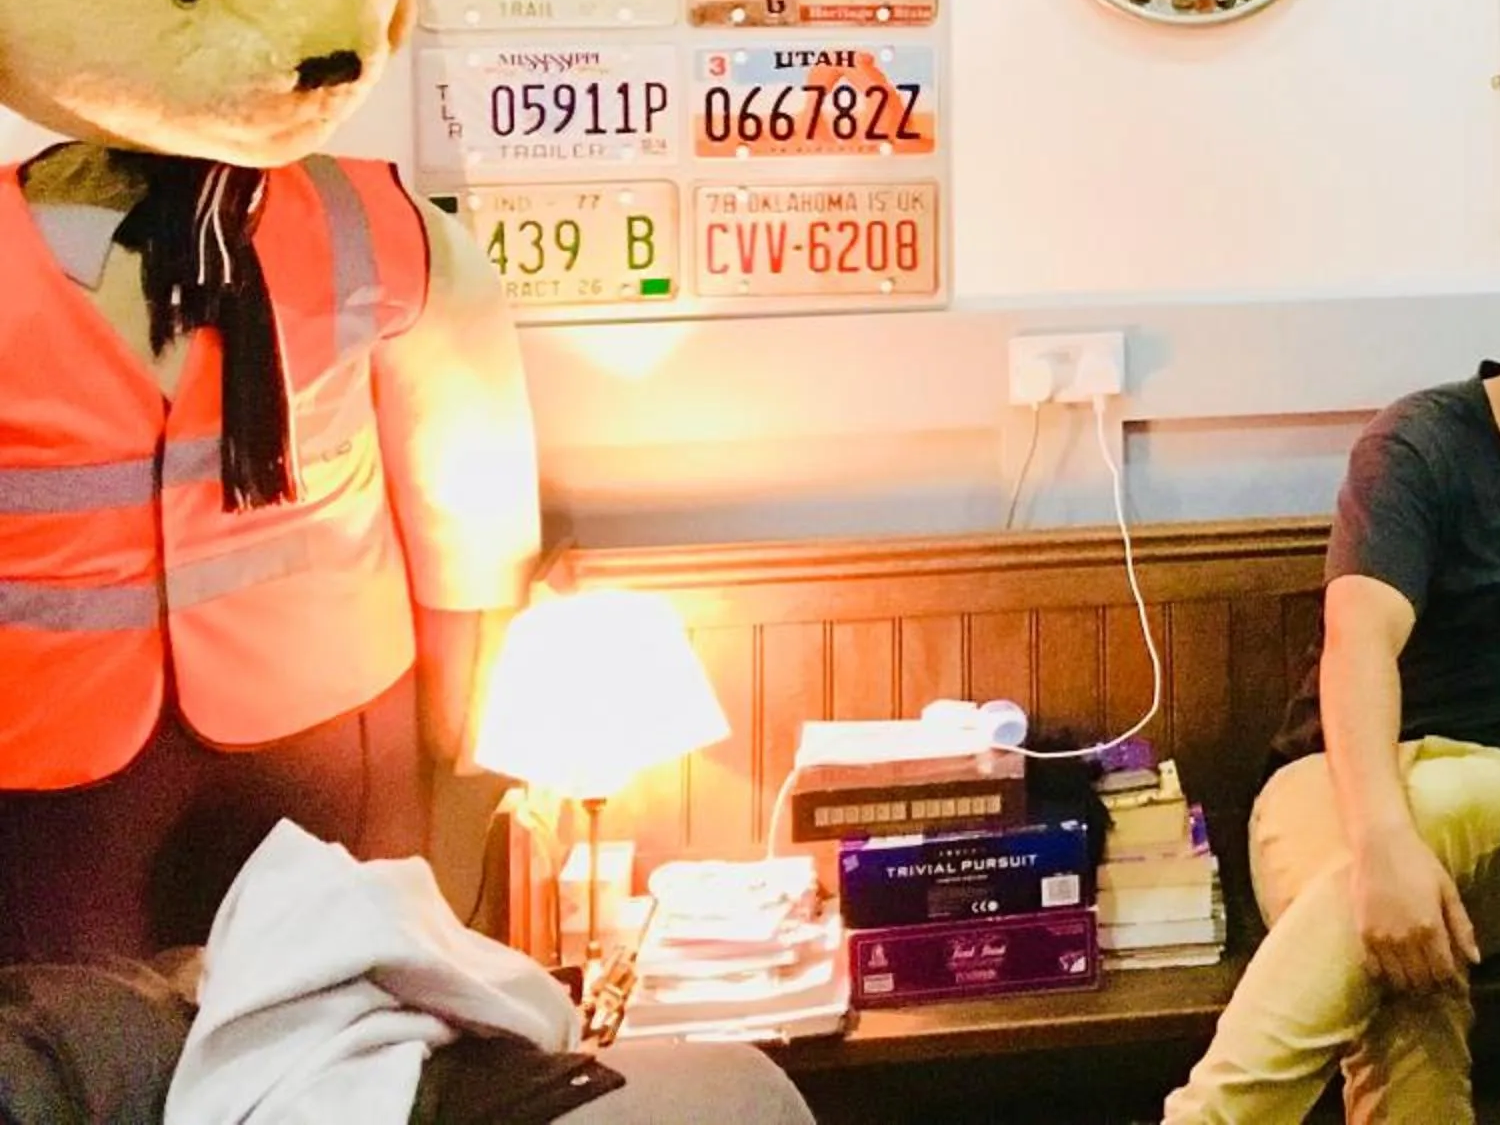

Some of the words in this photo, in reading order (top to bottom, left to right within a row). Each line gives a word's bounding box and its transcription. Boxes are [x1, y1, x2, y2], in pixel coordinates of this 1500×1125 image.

[498, 52, 599, 73] MISSISSIPPI
[709, 56, 726, 75] 3
[774, 51, 856, 69] UTAH
[491, 82, 667, 136] 05911P
[500, 145, 607, 159] TRAILER
[747, 193, 858, 213] OKLAHOMA
[869, 192, 890, 212] IS
[487, 219, 580, 275] 439
[627, 215, 654, 270] B
[707, 220, 917, 275] CVV-6208
[506, 281, 560, 297] RACT
[887, 865, 956, 878] TRIVIAL
[961, 855, 1038, 870] PURSUIT
